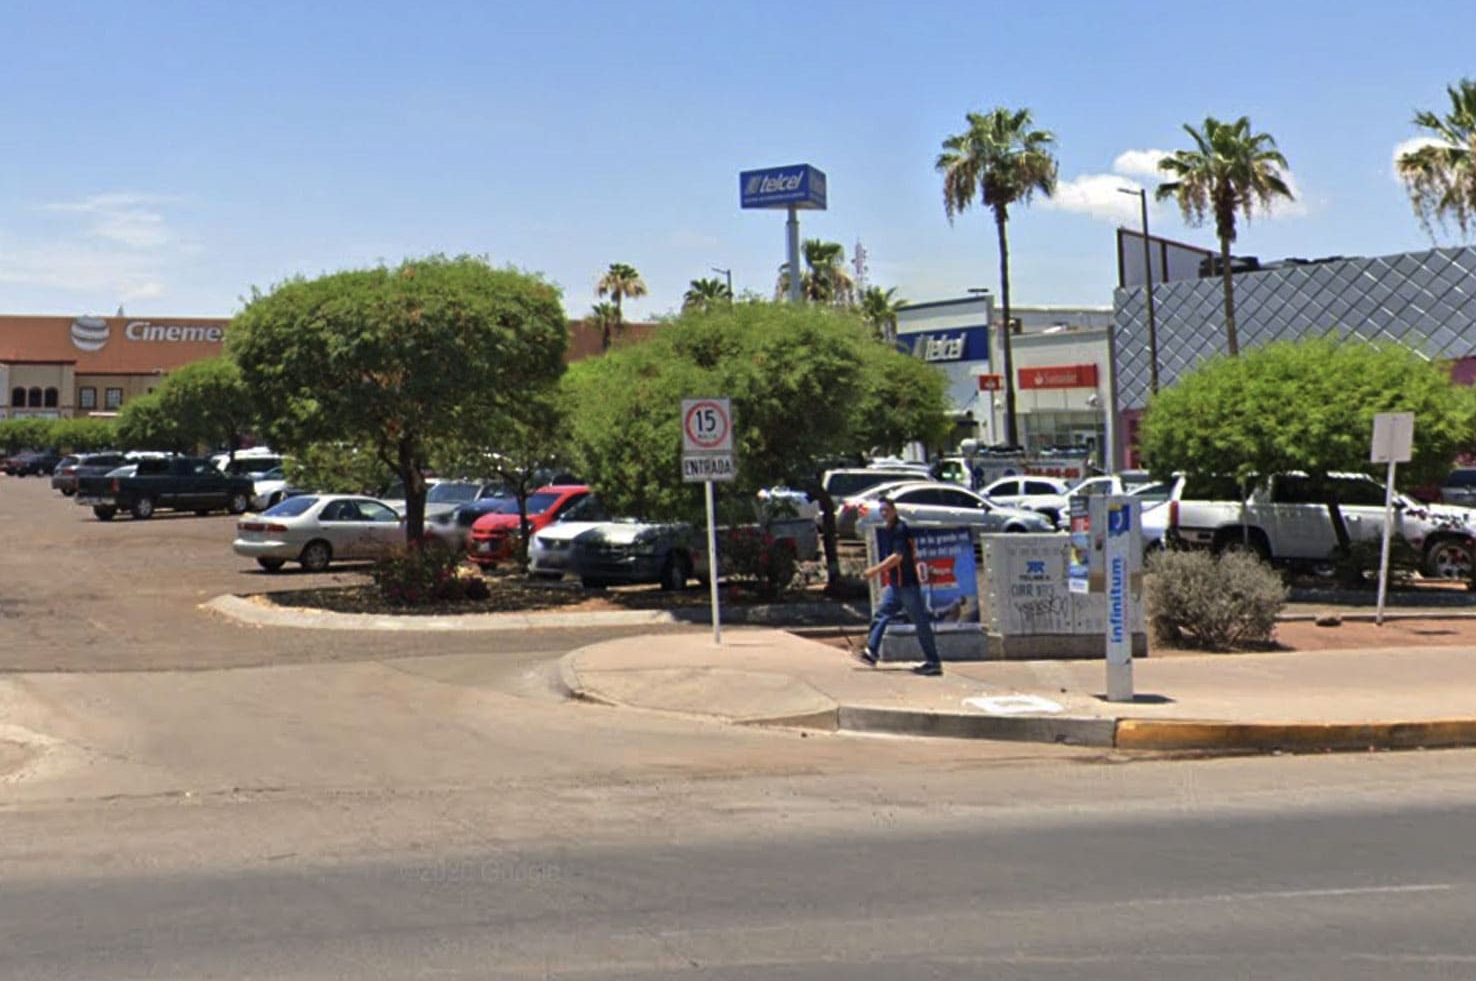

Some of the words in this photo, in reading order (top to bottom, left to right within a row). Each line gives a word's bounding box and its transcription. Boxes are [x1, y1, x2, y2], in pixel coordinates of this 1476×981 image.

[760, 171, 804, 193] telcel
[126, 321, 225, 342] Cineme
[696, 410, 716, 432] 15
[685, 459, 732, 476] ENTRADA
[1110, 557, 1123, 643] infinitum
